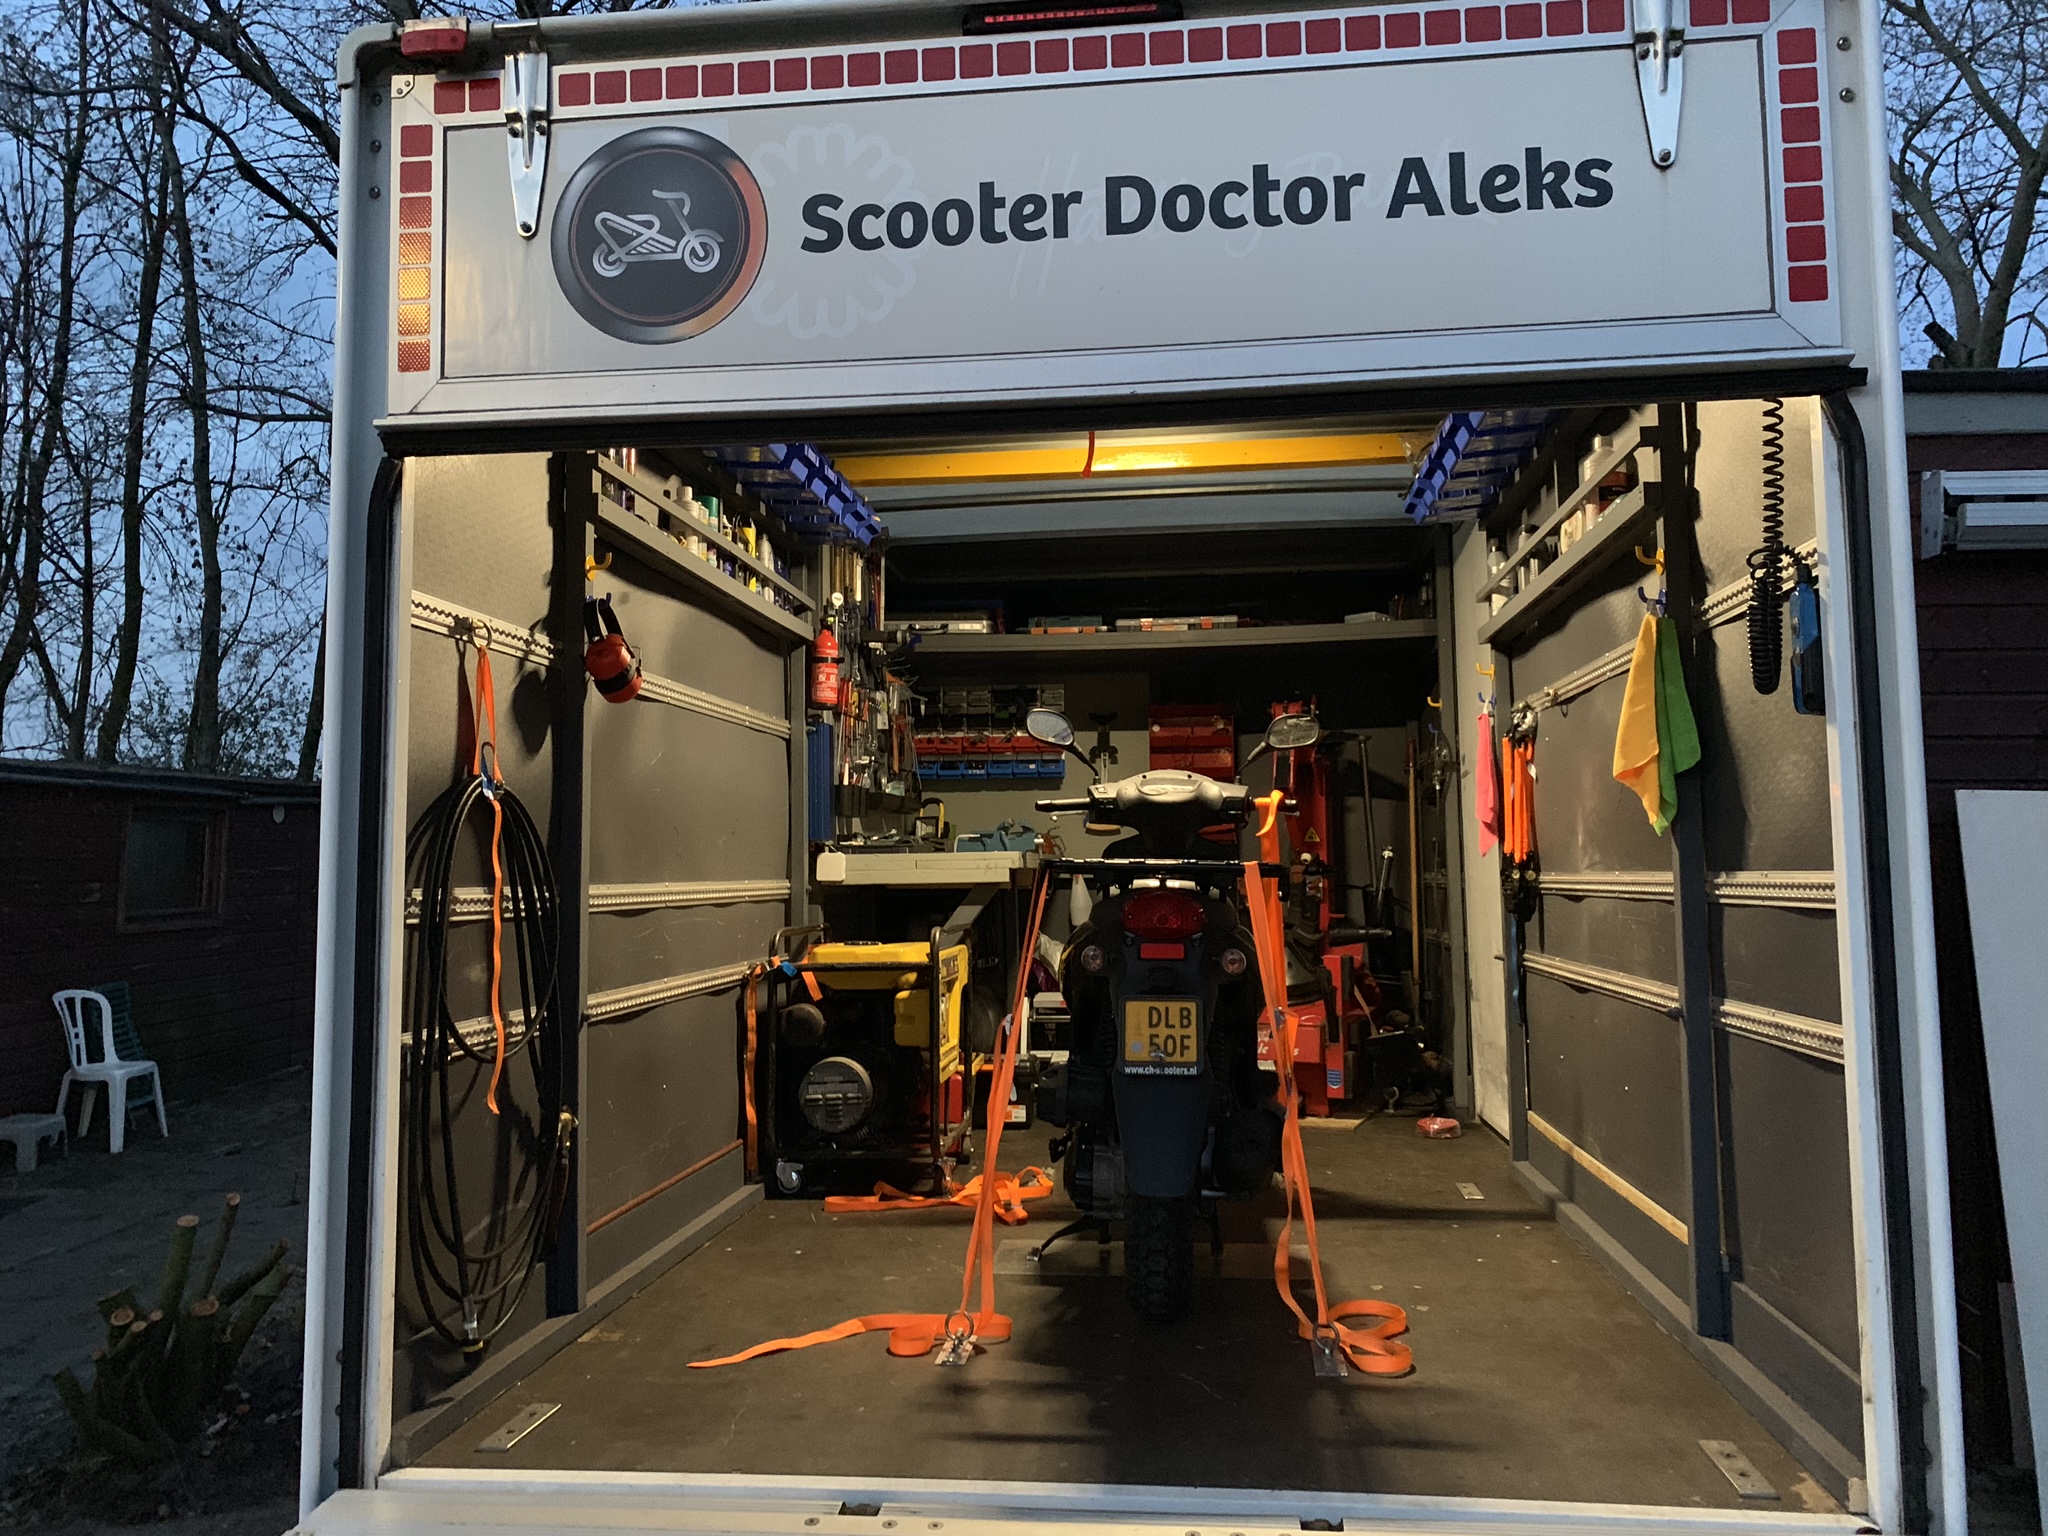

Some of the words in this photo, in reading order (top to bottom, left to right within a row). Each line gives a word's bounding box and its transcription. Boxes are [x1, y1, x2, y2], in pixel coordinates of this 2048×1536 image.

[800, 181, 1084, 254] Scooter
[1105, 163, 1366, 236] Doctor
[1385, 146, 1614, 219] Aleks
[1148, 1005, 1192, 1029] DLB
